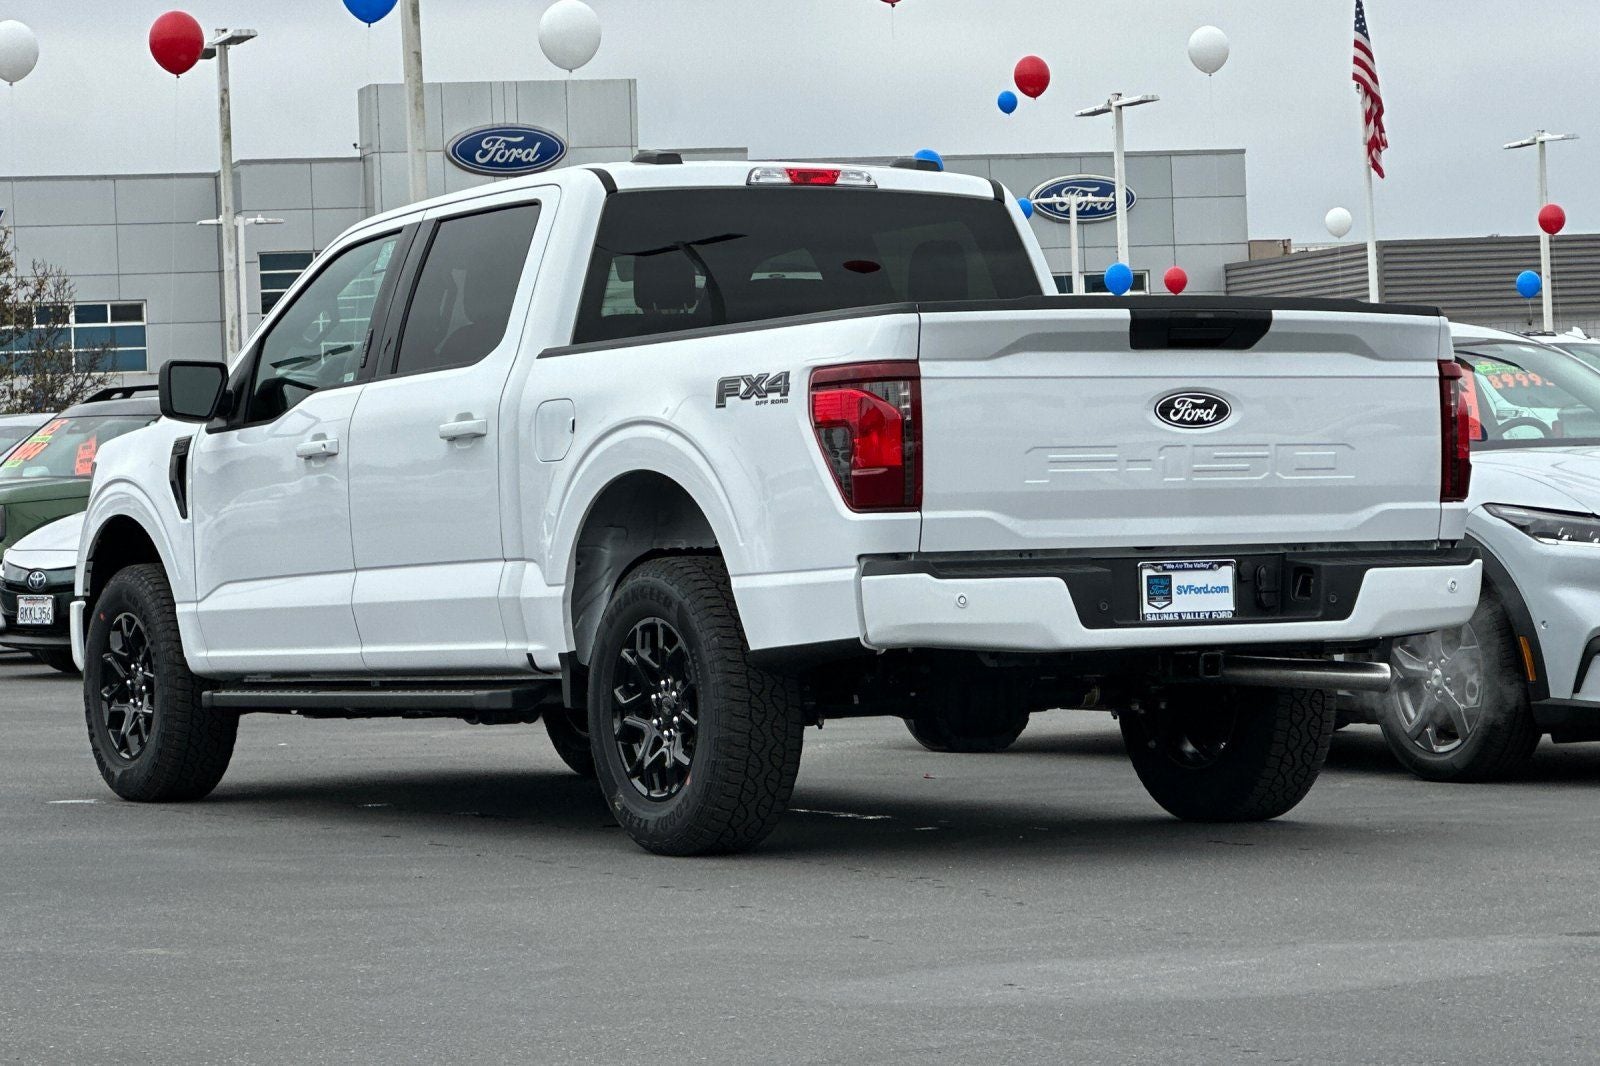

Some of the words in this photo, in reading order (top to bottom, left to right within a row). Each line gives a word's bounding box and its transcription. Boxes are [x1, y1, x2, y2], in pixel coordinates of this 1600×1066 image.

[475, 136, 541, 163] Ford
[716, 371, 790, 408] FX4
[1170, 397, 1217, 422] Ford
[1024, 443, 1356, 483] F-150
[1176, 583, 1229, 596] SVFord.com
[20, 606, 51, 620] 8KKL356
[1146, 612, 1179, 621] SALINAS
[1180, 611, 1210, 620] VALLEY
[1212, 610, 1233, 619] FORD
